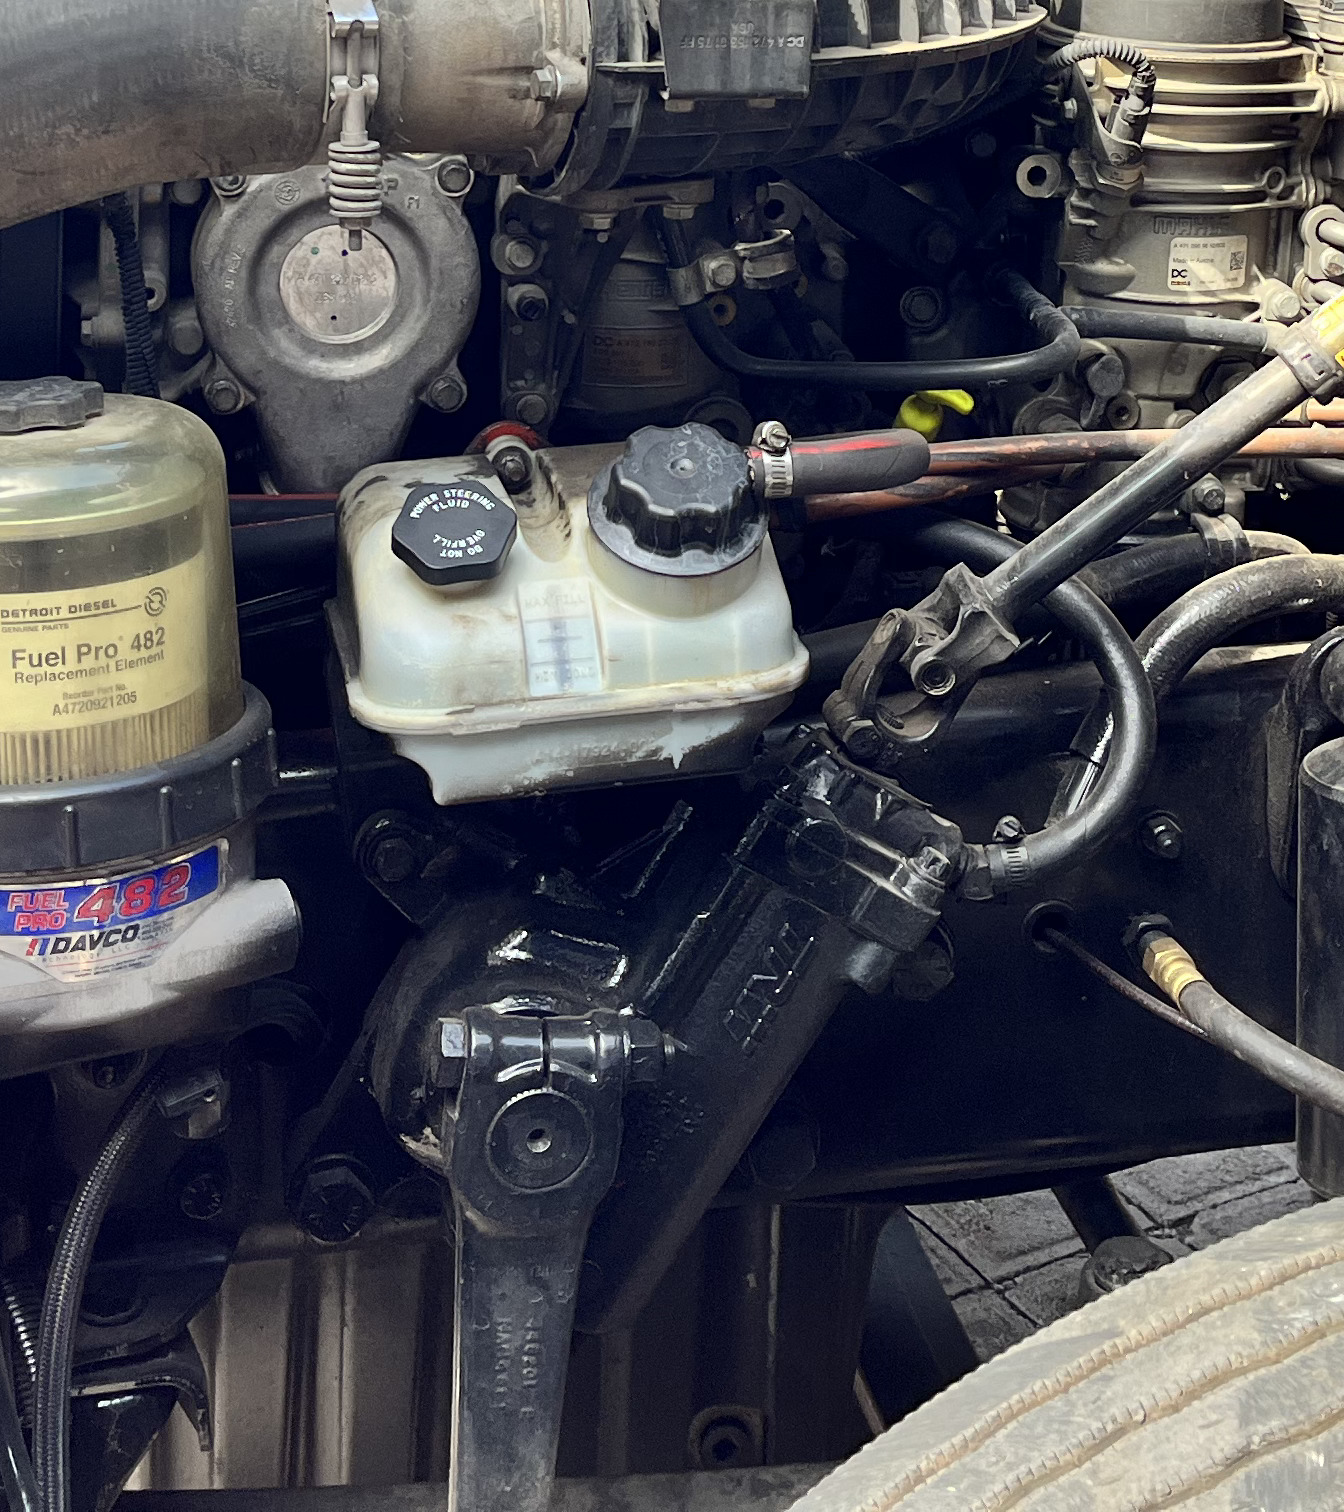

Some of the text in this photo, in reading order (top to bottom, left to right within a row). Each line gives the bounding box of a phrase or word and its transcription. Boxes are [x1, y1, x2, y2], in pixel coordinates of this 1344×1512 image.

[786, 35, 805, 48] DC
[409, 488, 497, 519] POWER STEERING
[431, 498, 470, 513] FLUID
[432, 529, 486, 549] OVERFILL
[440, 544, 484, 558] DO NOT
[0, 598, 118, 620] DETROIT DIESEL
[524, 594, 586, 608] MAX FILL
[1, 624, 39, 634] GENUINE
[11, 626, 166, 670] Fuel Pro 482
[14, 648, 165, 686] Replacement Element
[52, 691, 138, 717] A4720921205
[7, 890, 69, 913] FUEL
[74, 861, 192, 926] 482
[14, 911, 67, 932] PRO
[49, 923, 141, 956] DAVCO
